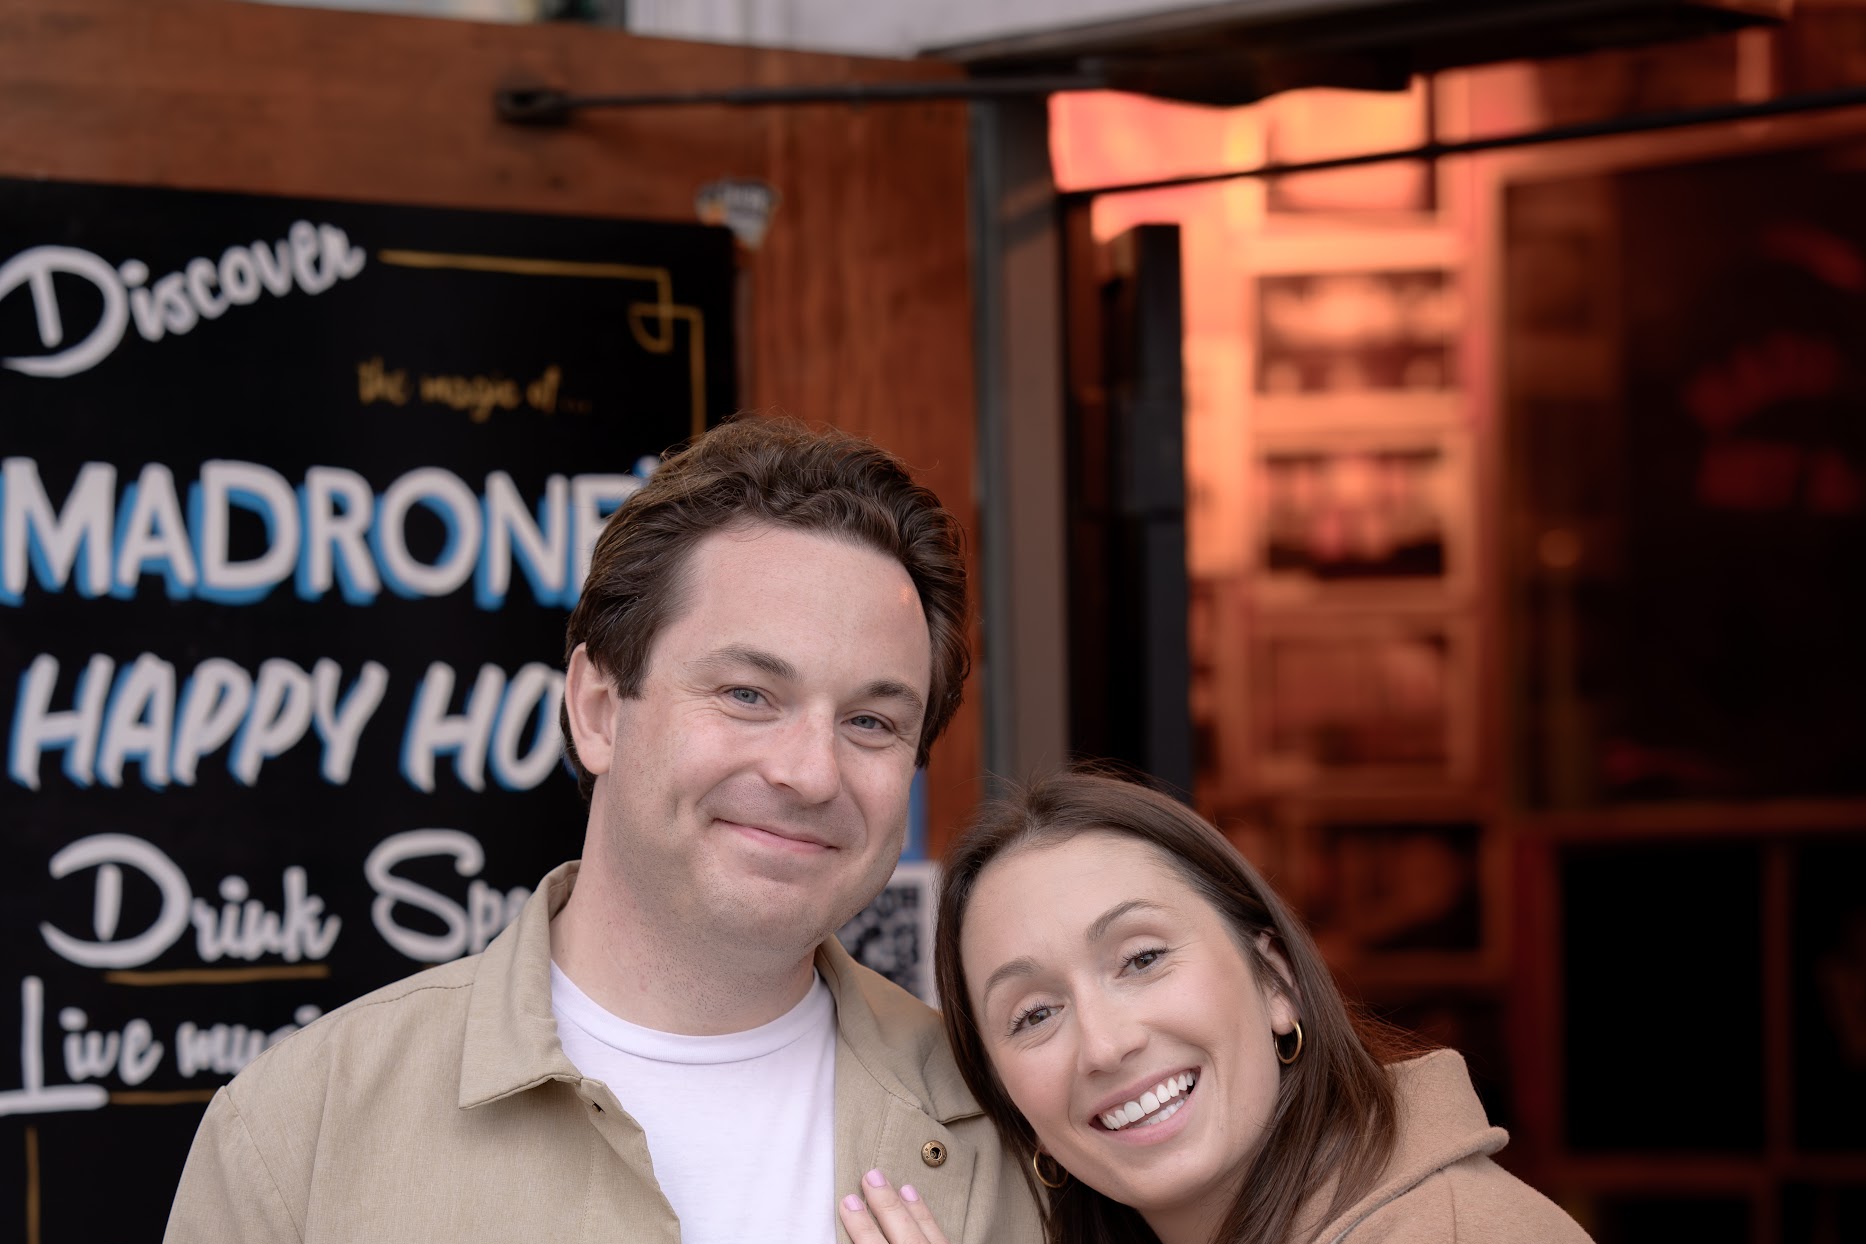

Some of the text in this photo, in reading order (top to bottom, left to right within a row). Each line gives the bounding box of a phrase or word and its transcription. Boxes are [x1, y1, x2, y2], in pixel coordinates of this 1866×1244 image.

[0, 220, 366, 378] Discover
[357, 355, 412, 406] the
[419, 370, 523, 424] magic
[7, 652, 578, 793] HAPPY HO
[40, 832, 342, 969] Drink
[0, 975, 165, 1117] Live
